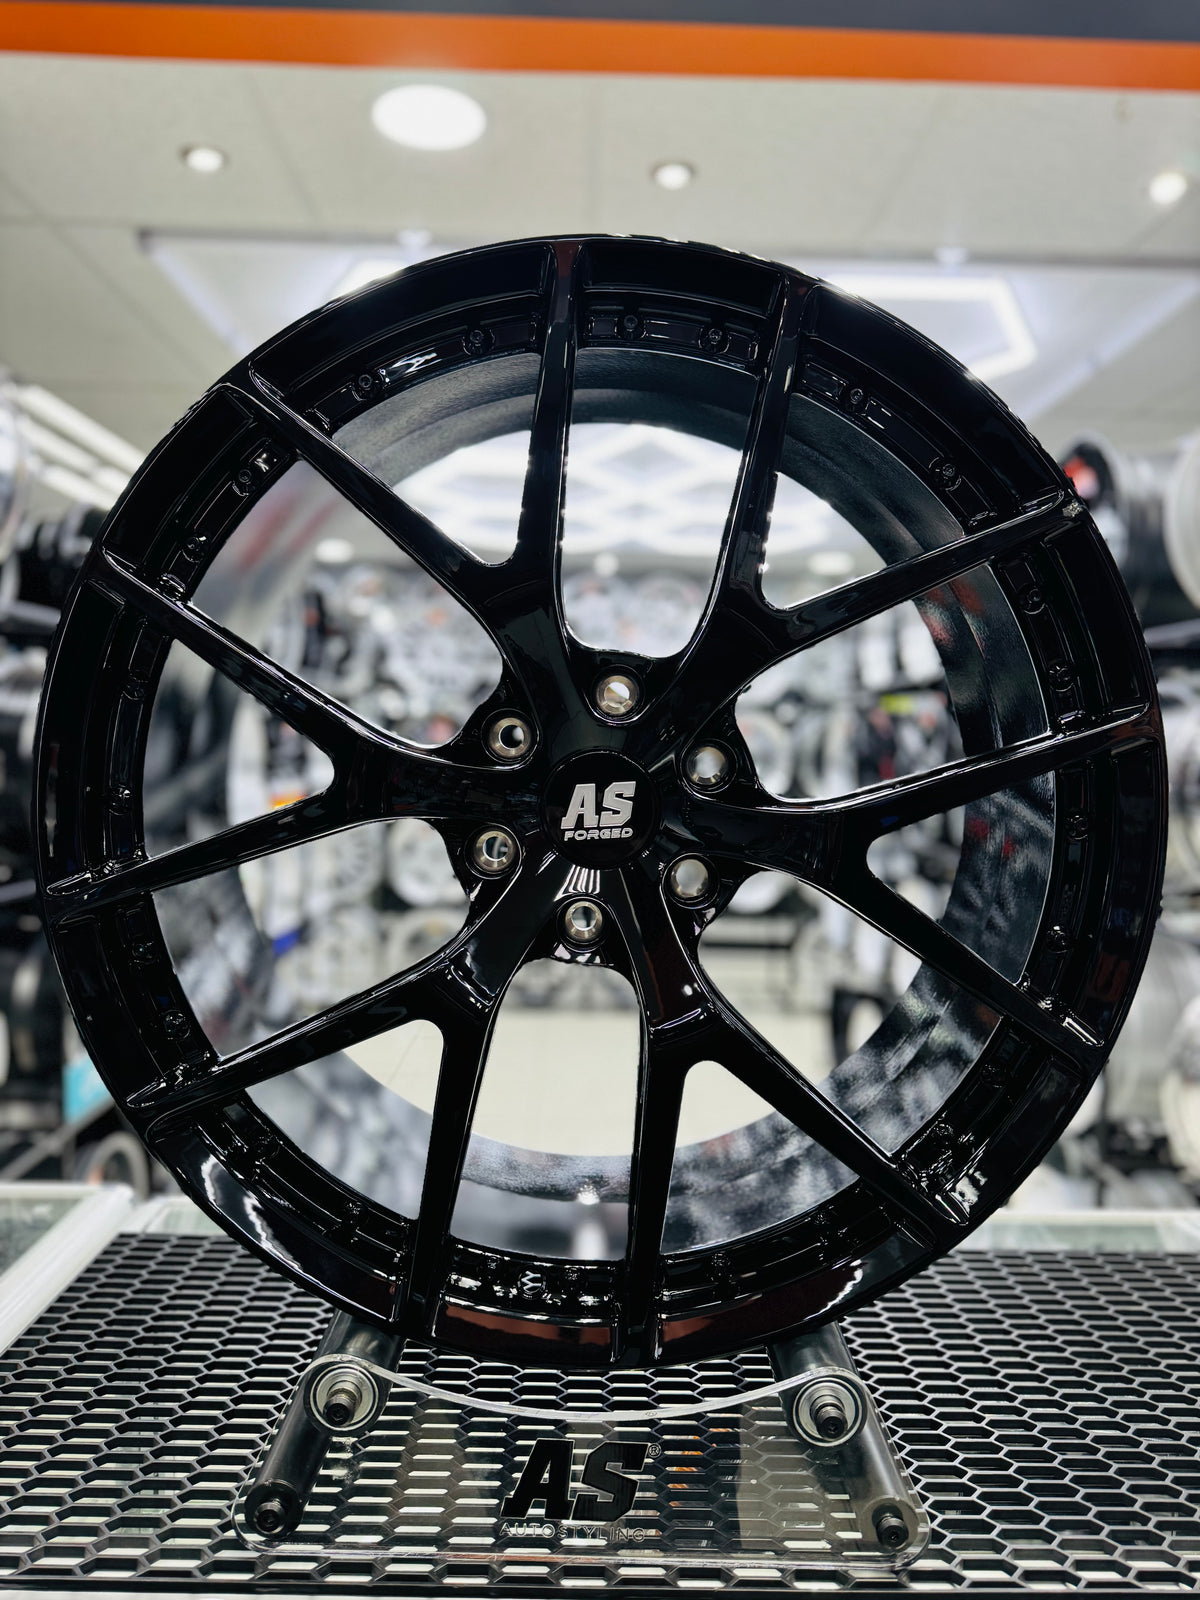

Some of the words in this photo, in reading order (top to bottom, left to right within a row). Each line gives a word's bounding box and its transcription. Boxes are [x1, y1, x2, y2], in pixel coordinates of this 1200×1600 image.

[561, 781, 636, 829] AS
[564, 828, 633, 841] FORGED
[500, 1522, 645, 1542] AUTOSTYLING
